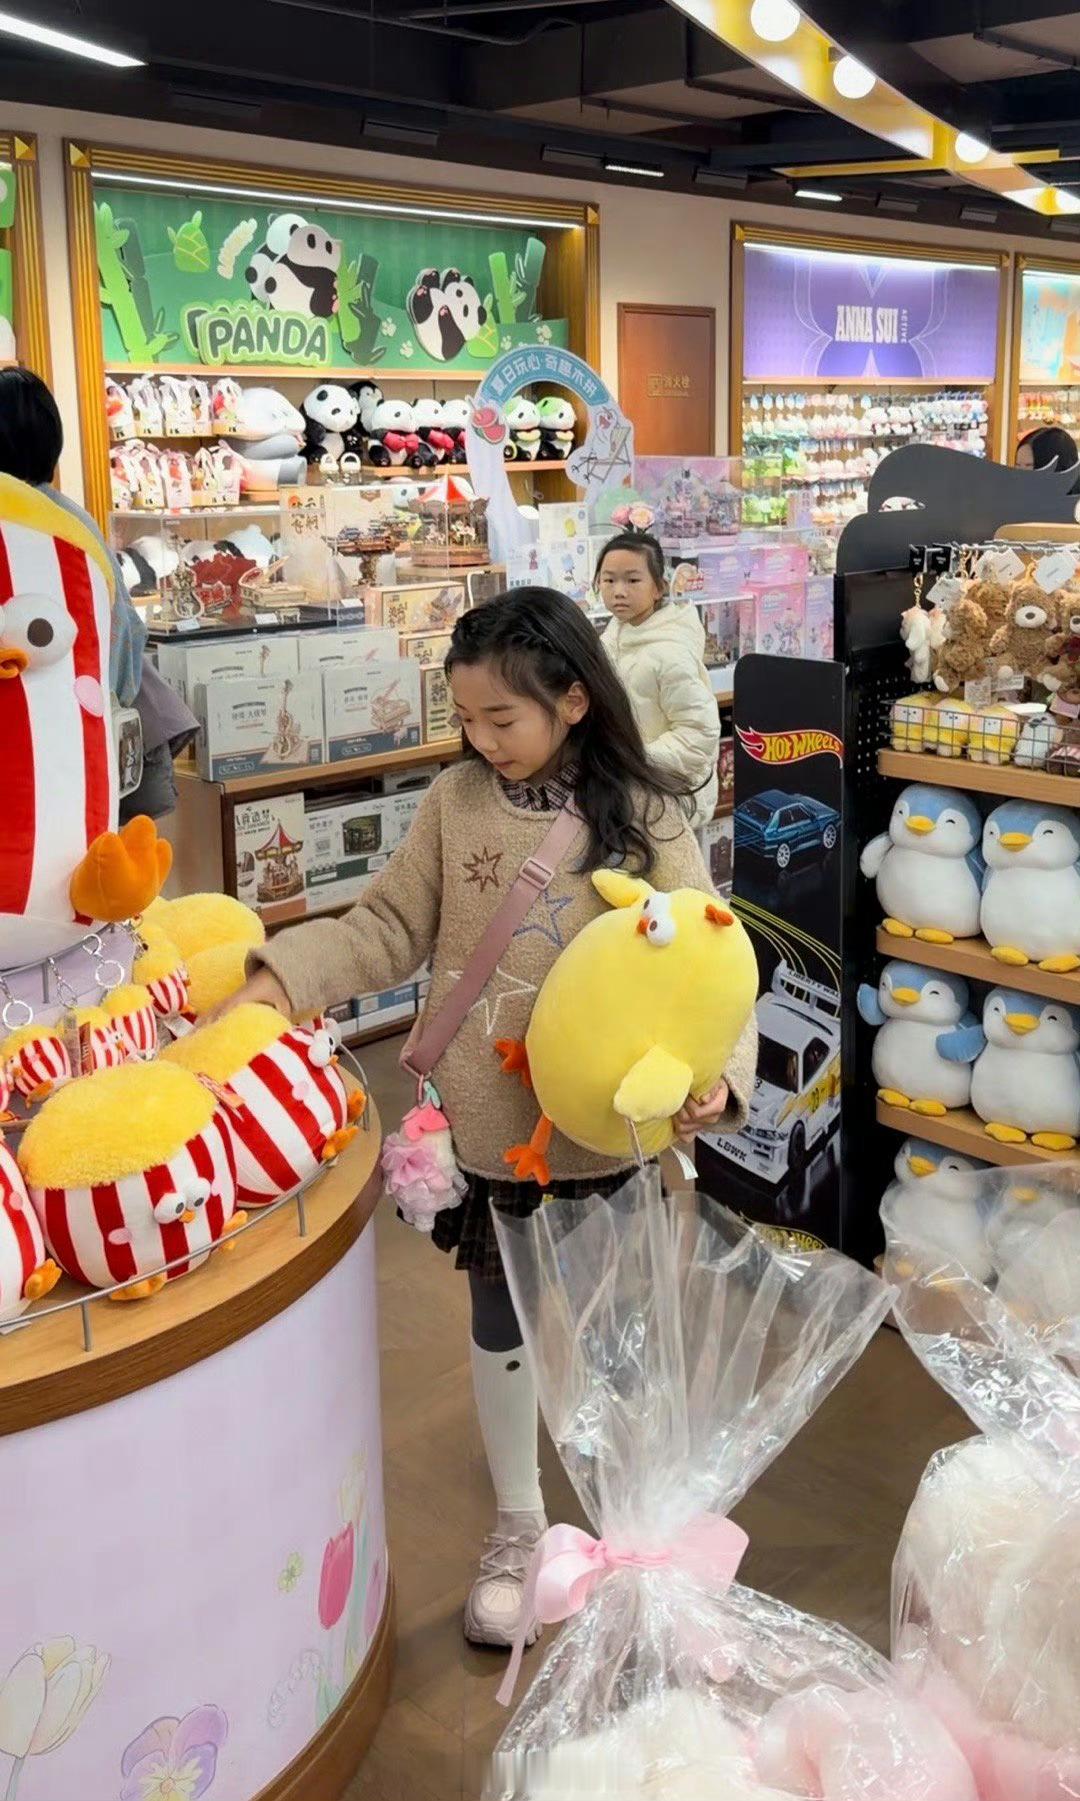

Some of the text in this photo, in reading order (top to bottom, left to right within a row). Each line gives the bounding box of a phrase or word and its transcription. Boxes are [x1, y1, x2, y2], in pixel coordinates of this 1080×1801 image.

[208, 316, 327, 362] PANDA
[835, 305, 899, 344] ANNA SUI
[901, 308, 909, 343] ACTIVE
[761, 735, 791, 762] HOT
